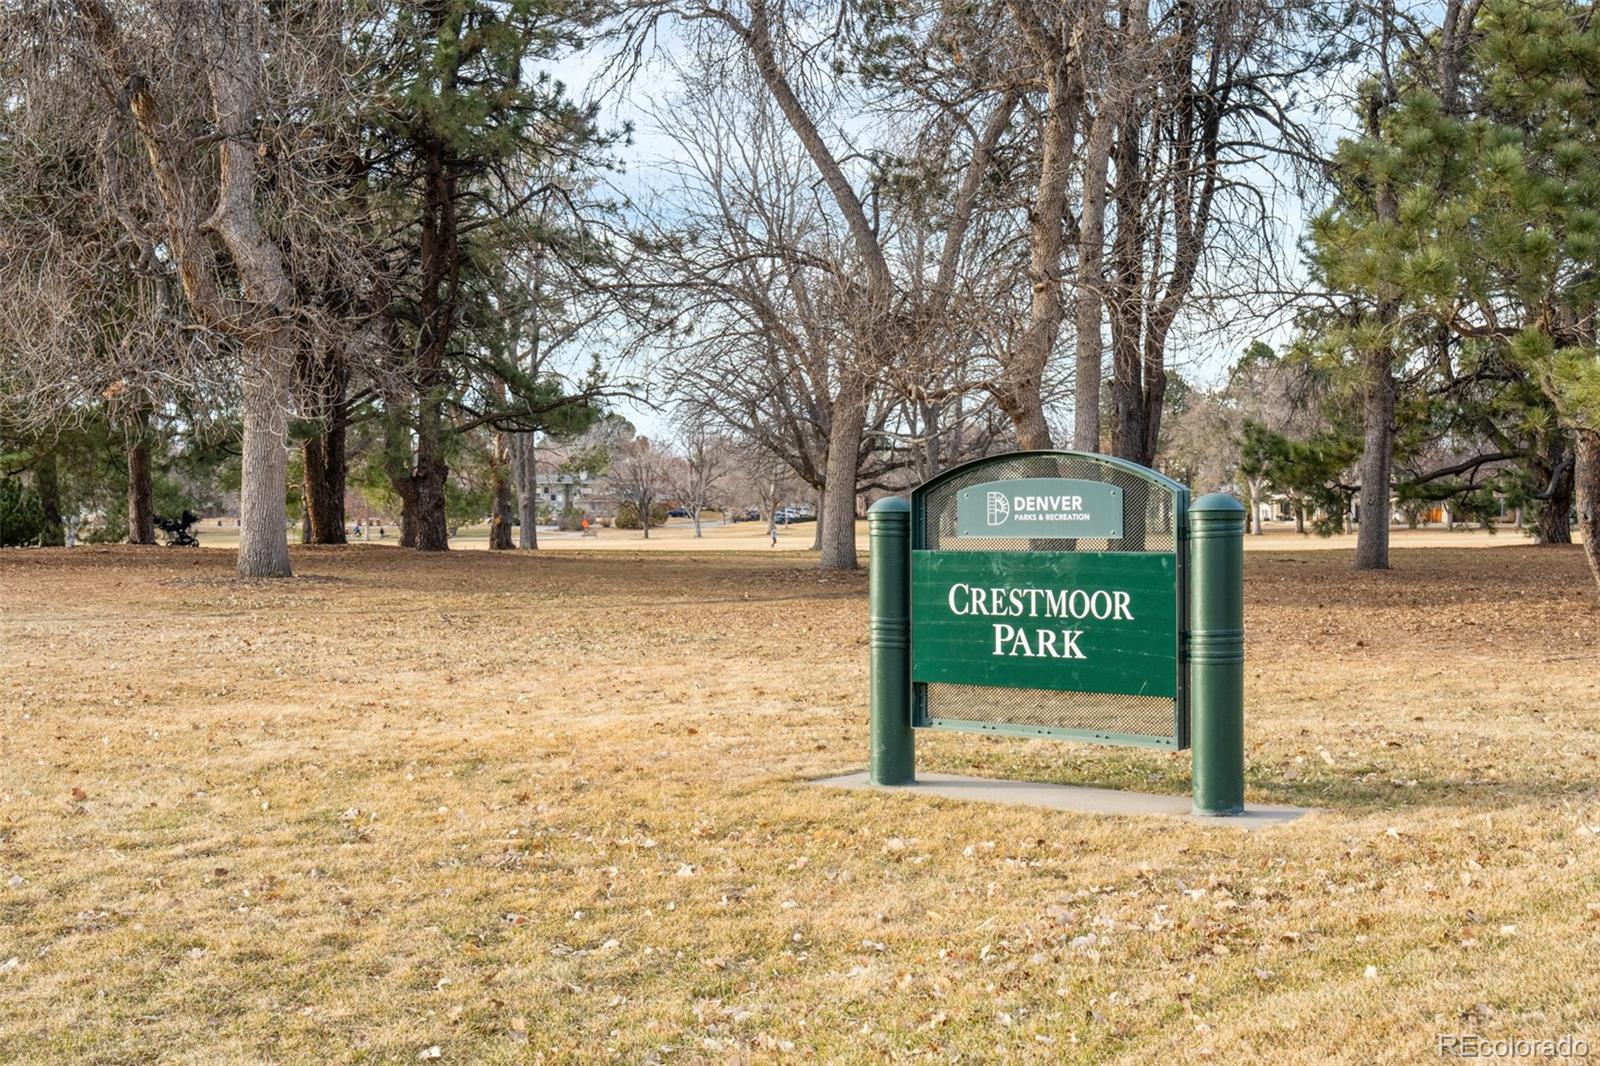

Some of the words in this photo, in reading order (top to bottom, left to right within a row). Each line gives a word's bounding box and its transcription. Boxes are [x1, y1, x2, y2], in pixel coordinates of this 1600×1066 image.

[1014, 496, 1082, 511] DENVER
[1045, 513, 1090, 521] RECREATION
[948, 583, 1134, 621] CRESTMOOR
[992, 624, 1087, 659] PARK
